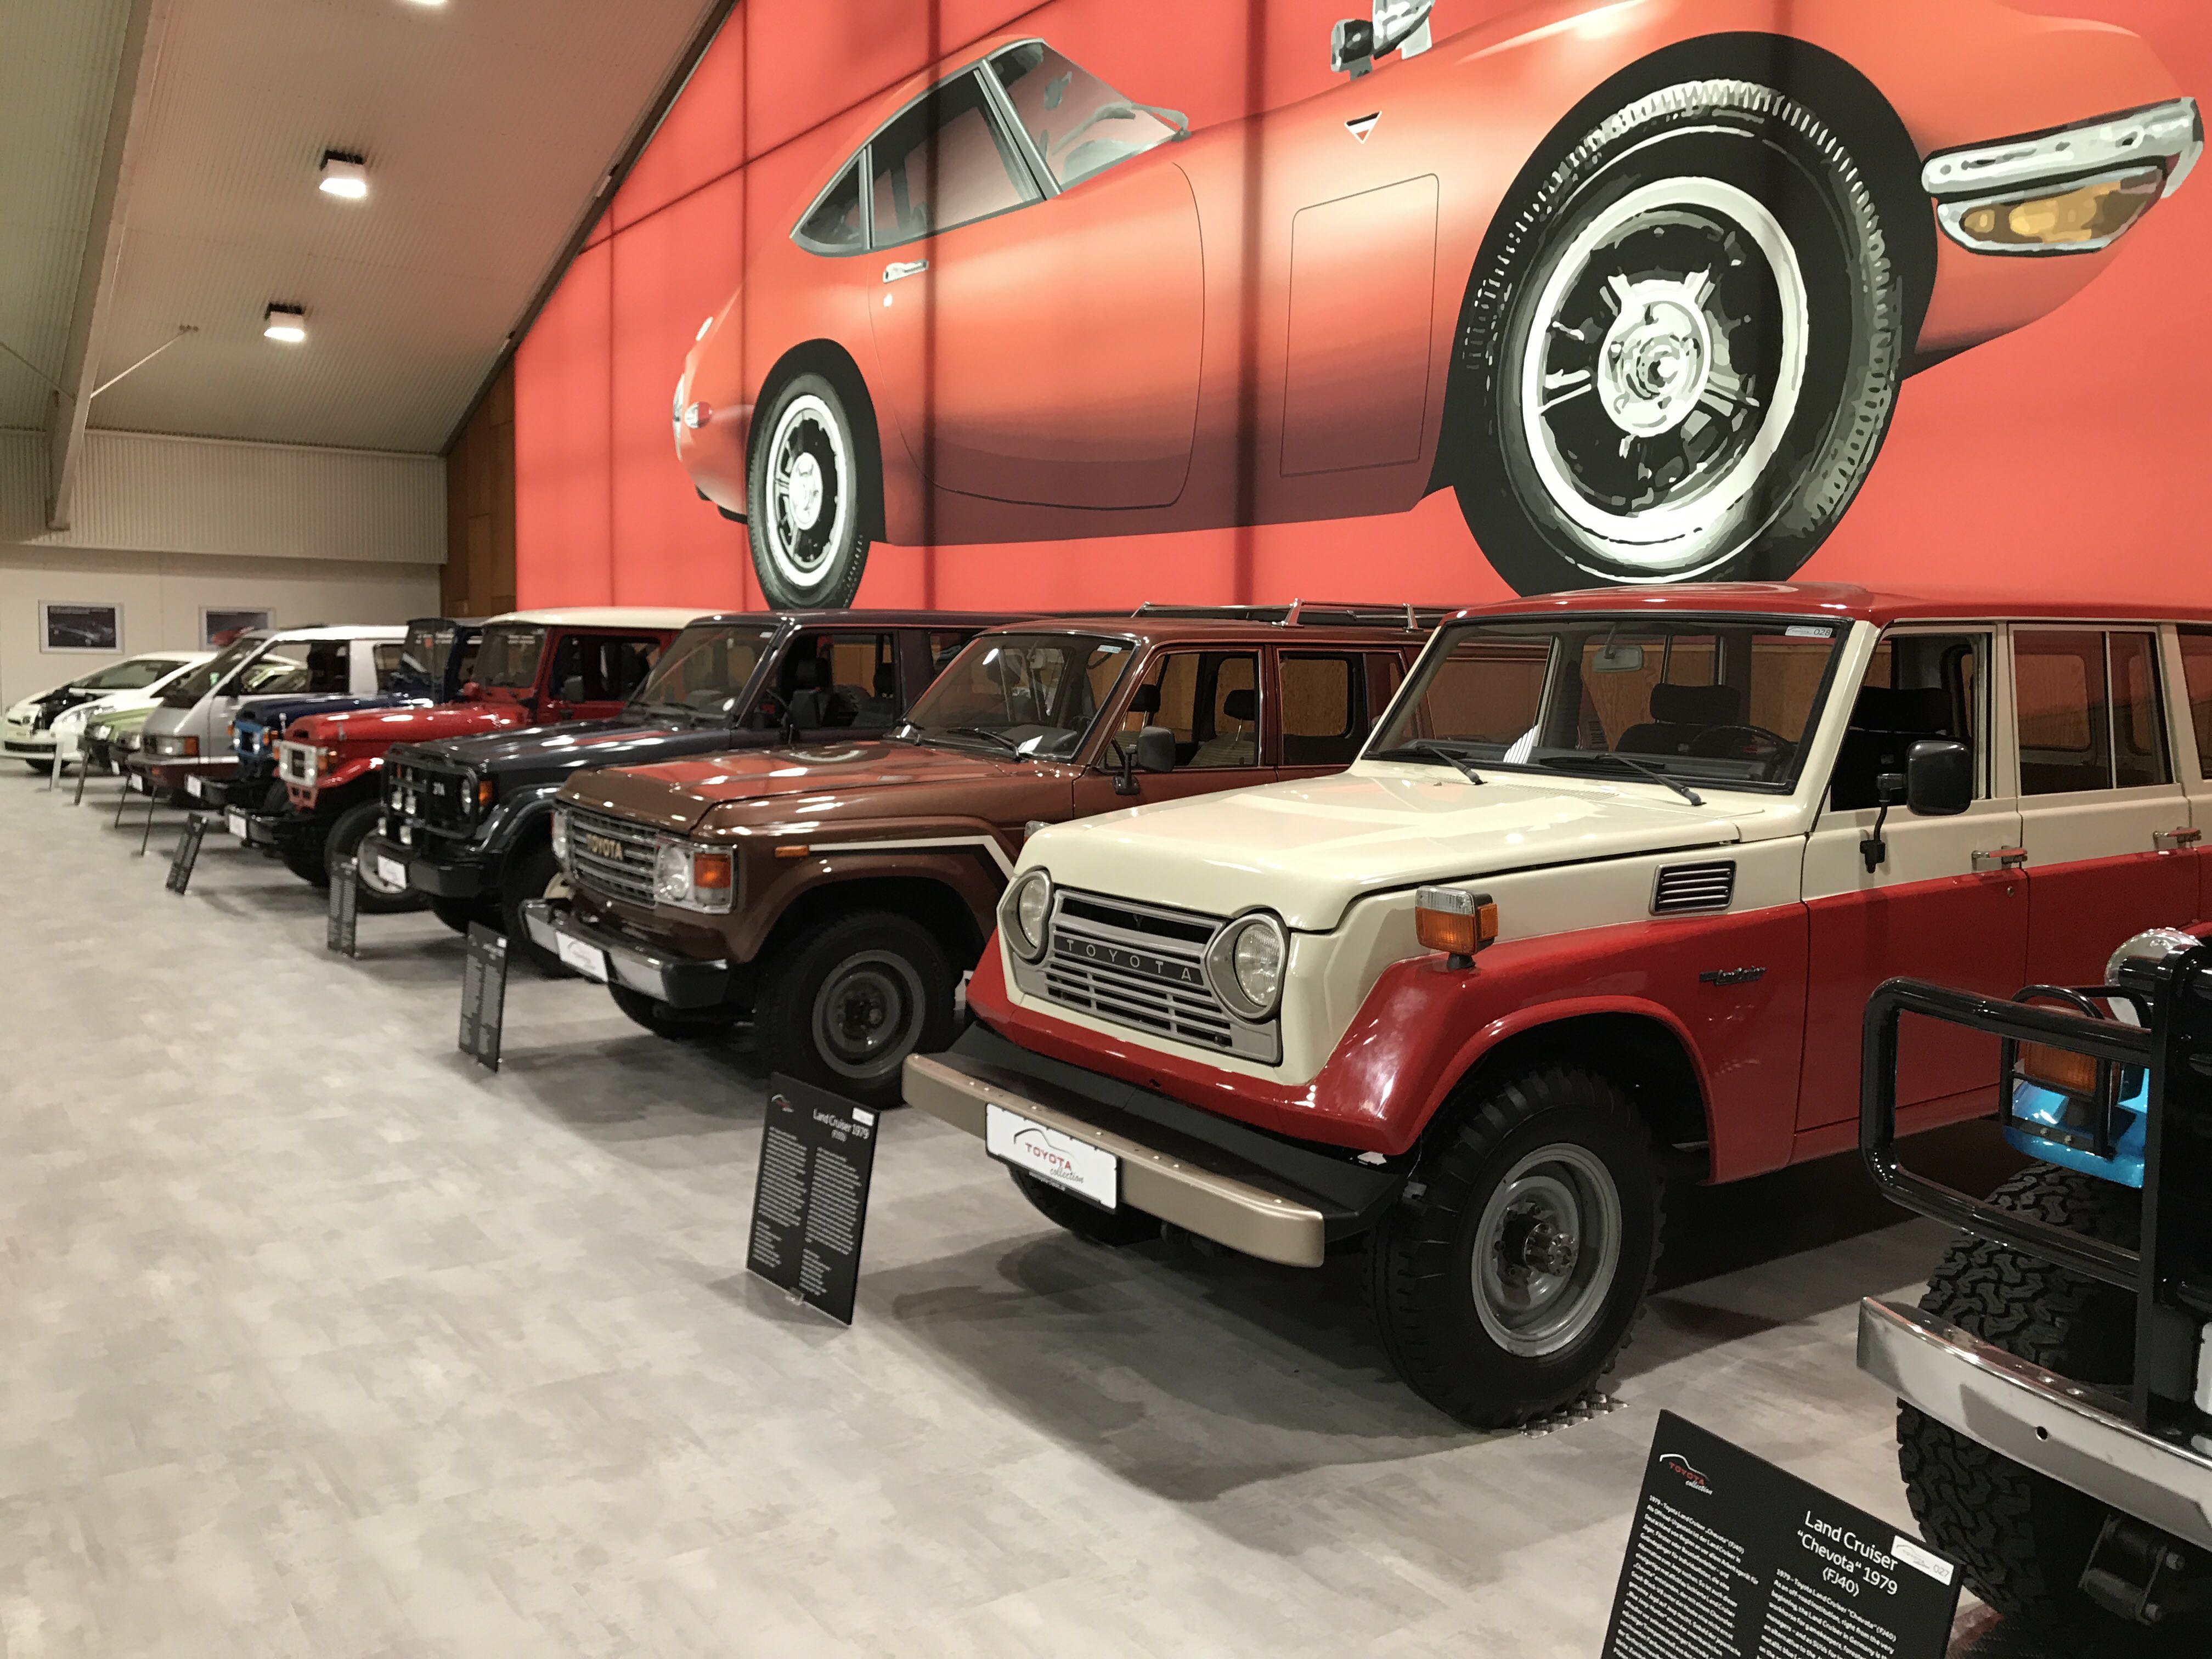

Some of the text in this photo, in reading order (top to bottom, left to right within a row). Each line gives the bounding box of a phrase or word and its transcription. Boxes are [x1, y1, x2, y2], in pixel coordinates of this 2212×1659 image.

[586, 833, 623, 860] TOYOTA
[1066, 939, 1191, 981] TOYOTA
[1025, 1142, 1072, 1171] TOYOTA
[1049, 1165, 1084, 1183] collection
[1669, 1462, 1706, 1487] TOYOTA
[1805, 1511, 1898, 1570] Land Cruiser
[1822, 1567, 1859, 1596] (FJ40)
[1863, 1567, 1897, 1594] 1979
[1932, 1562, 1950, 1579] 027
[1777, 1569, 1791, 1580] 1979
[1795, 1578, 1813, 1593] Toyota
[1812, 1589, 1827, 1602] Land
[1826, 1598, 1847, 1613] Cruiser
[1876, 1627, 1896, 1642] (FJ40)
[1808, 1612, 1822, 1624] Land
[1822, 1620, 1843, 1636] Cruiser
[1849, 1636, 1875, 1656] Germany
[1870, 1635, 1881, 1645] the
[1880, 1643, 1894, 1654] very
